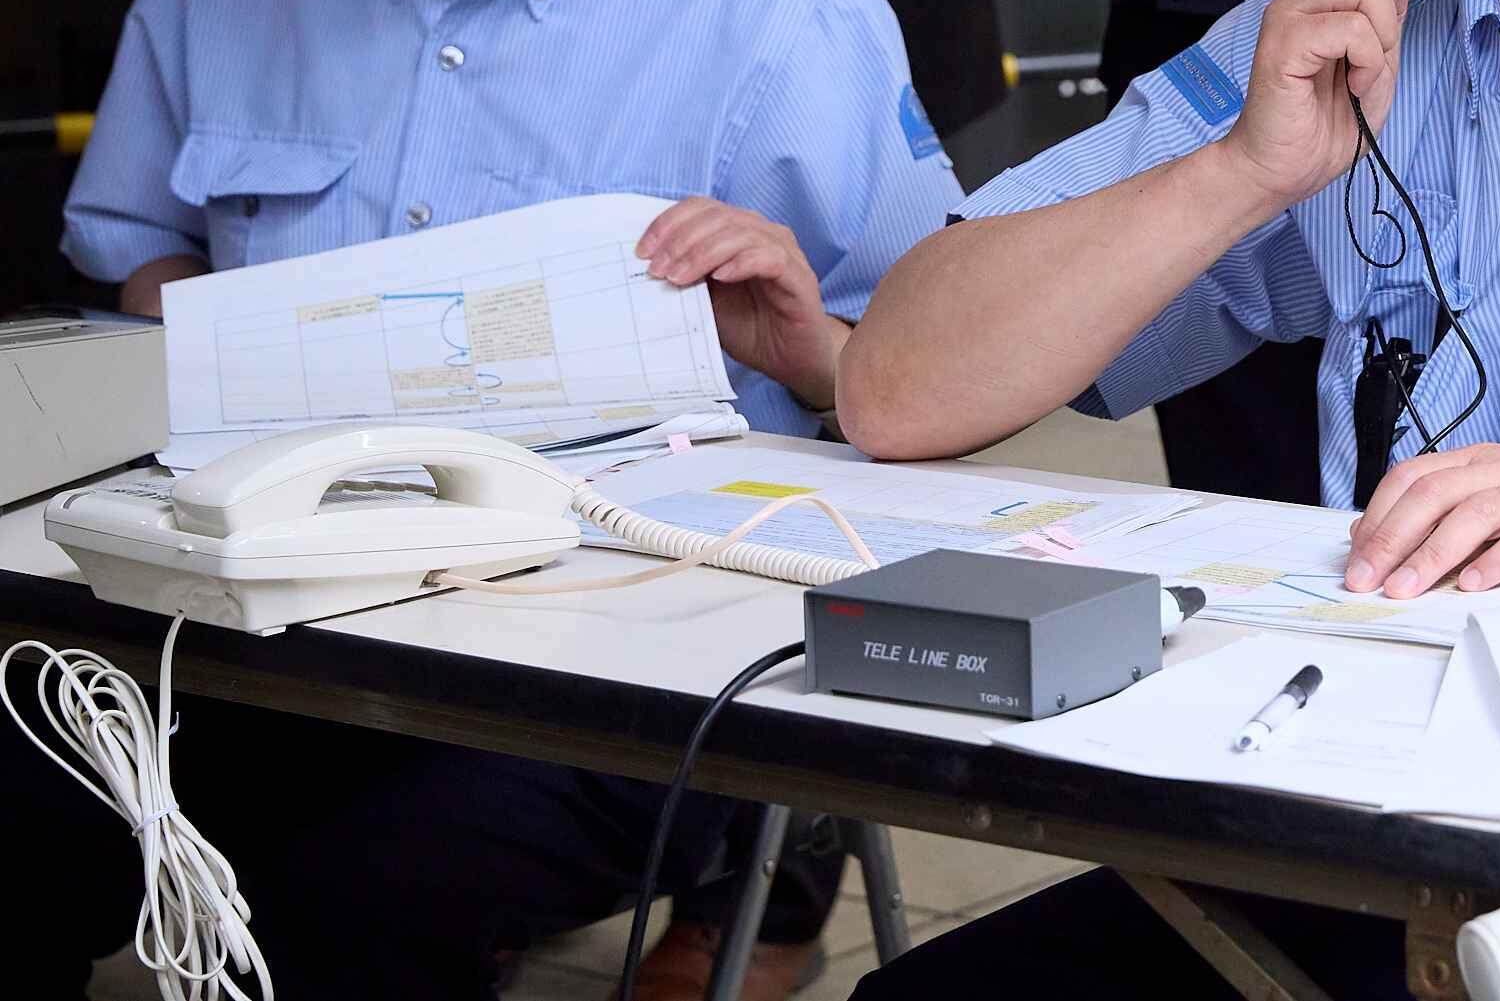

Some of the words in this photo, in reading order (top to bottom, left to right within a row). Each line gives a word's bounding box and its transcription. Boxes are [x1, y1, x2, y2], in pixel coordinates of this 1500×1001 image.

[863, 641, 903, 661] TELE
[908, 647, 949, 668] LINE
[956, 654, 988, 673] BOX
